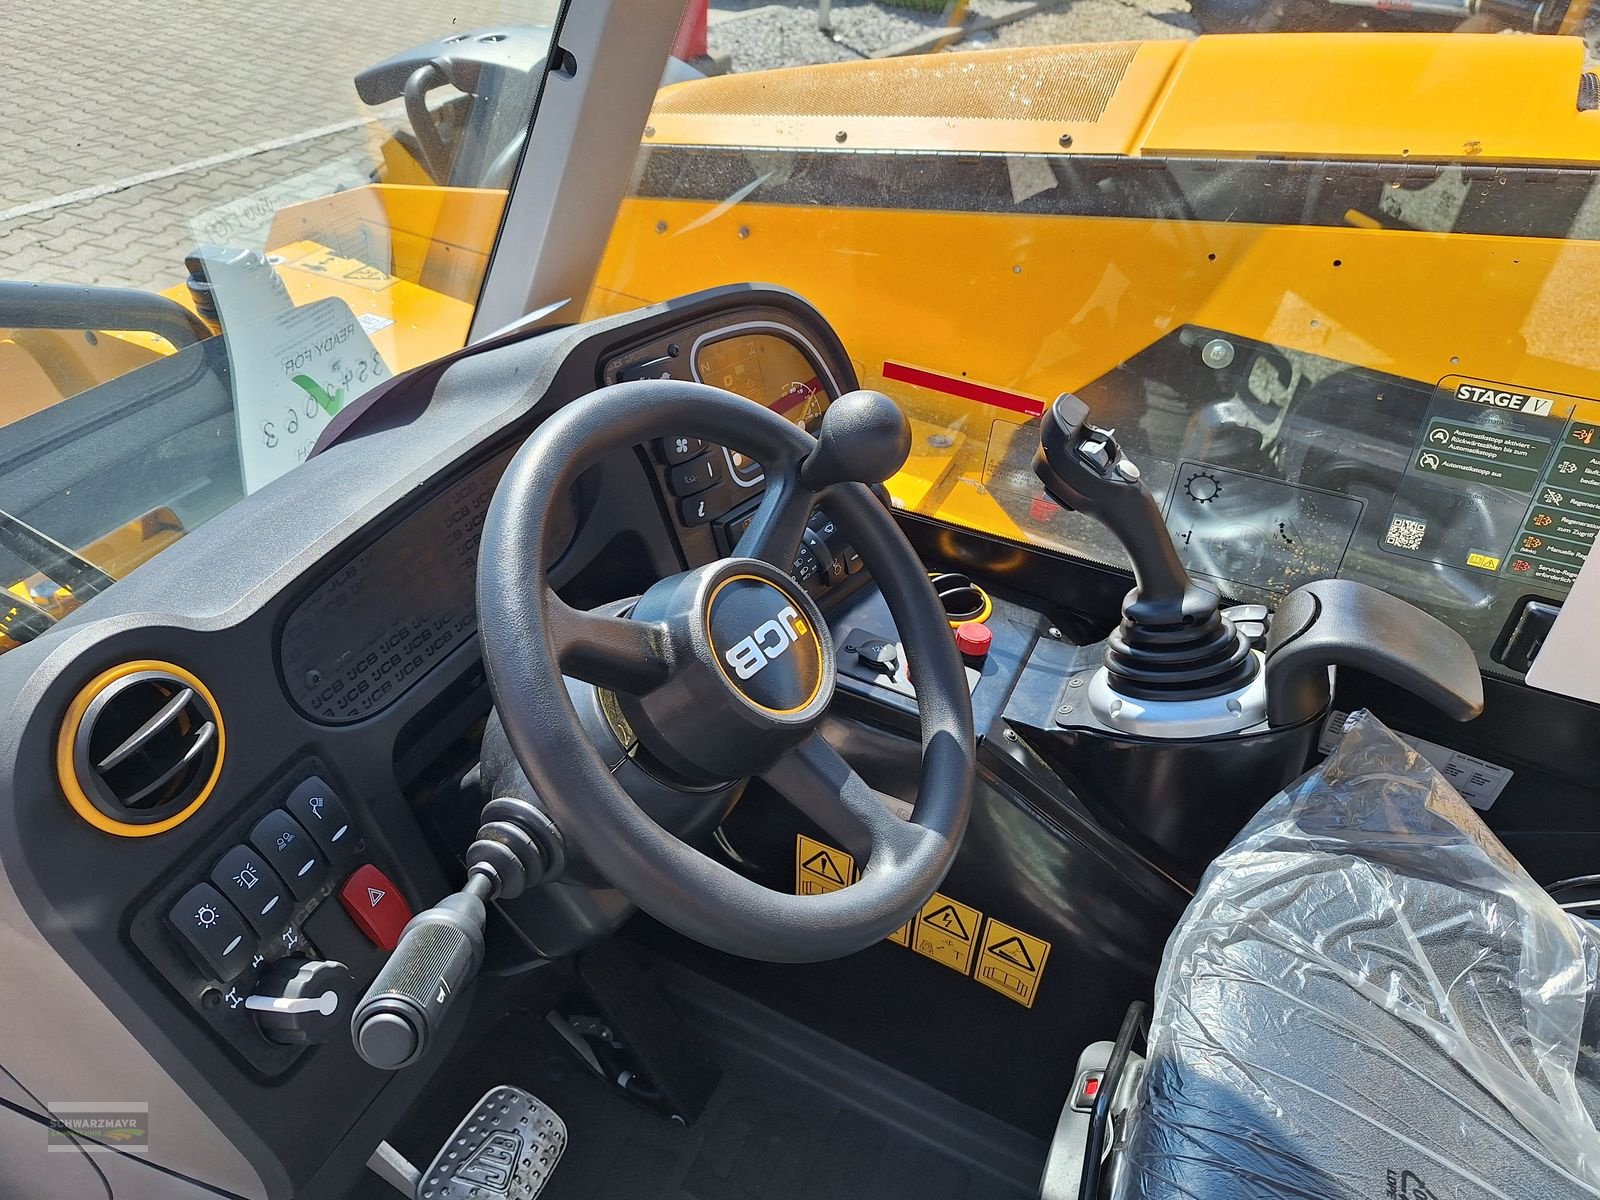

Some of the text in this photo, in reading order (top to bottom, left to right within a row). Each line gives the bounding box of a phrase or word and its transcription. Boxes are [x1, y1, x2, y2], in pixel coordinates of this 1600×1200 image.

[1457, 384, 1548, 413] STAGE V
[1450, 436, 1528, 457] Rückwärtszählen bis zum
[1453, 429, 1503, 444] Automatikstopp
[1503, 439, 1531, 450] aktiviert
[1447, 443, 1498, 459] Automatikstopp
[1441, 460, 1491, 476] Automatikstopp
[1571, 528, 1596, 539] Zugriff
[1546, 545, 1575, 557] Manuelle
[1535, 572, 1572, 584] erforderlich
[725, 606, 806, 680] JCB
[467, 1138, 517, 1187] JCB
